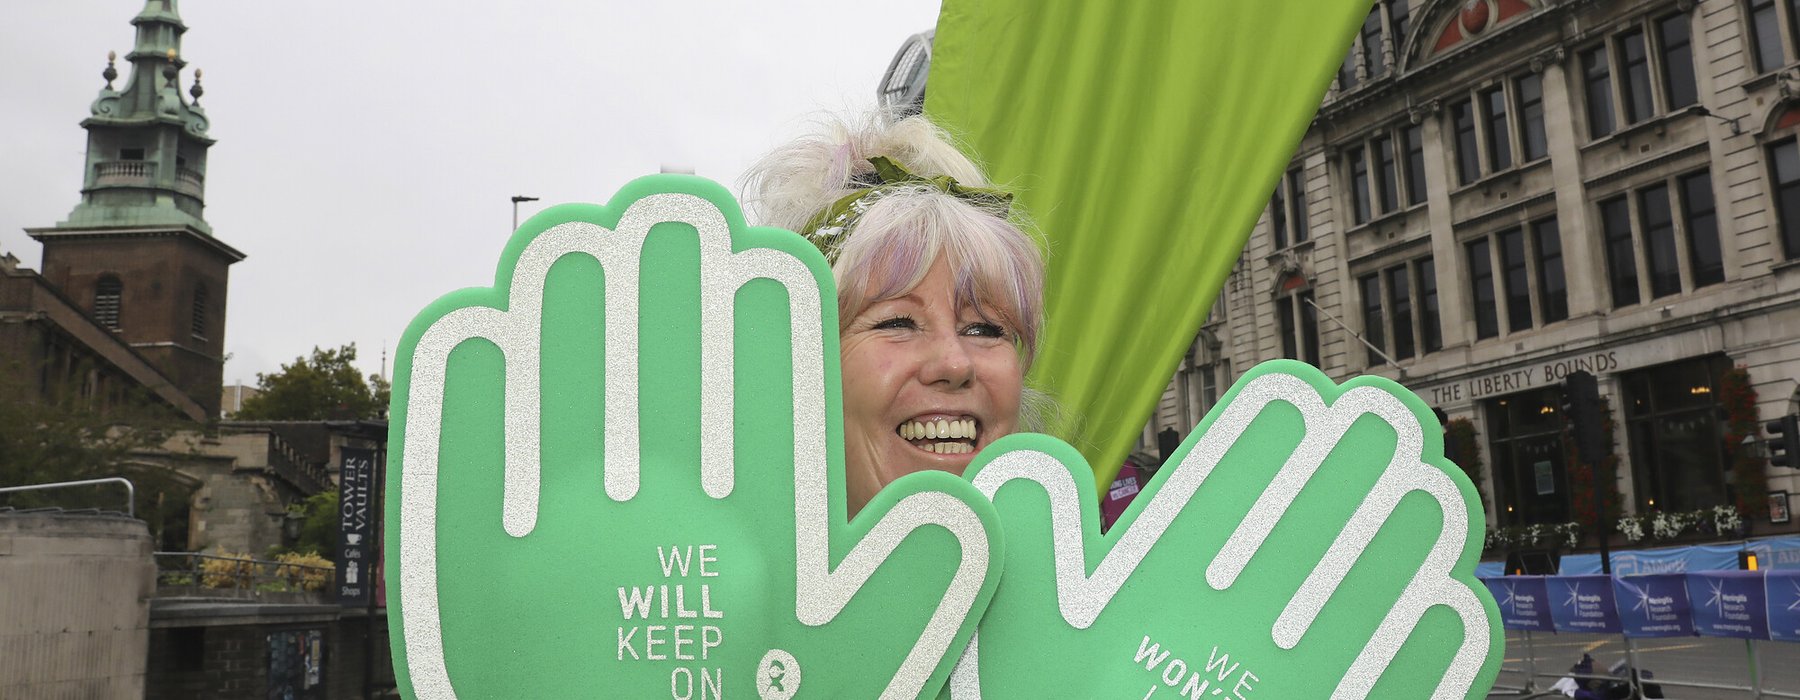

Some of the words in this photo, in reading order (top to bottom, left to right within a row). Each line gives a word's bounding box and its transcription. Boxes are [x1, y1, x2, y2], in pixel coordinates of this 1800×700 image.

[1432, 384, 1461, 404] THE
[1469, 369, 1534, 397] LIBERTY
[1544, 351, 1618, 383] BOUNDS
[342, 457, 356, 531] TOWER
[355, 460, 369, 531] VAULTS
[657, 544, 719, 577] WE
[342, 586, 361, 597] Shops
[617, 584, 724, 620] WILL
[617, 625, 723, 660] KEEP
[671, 667, 722, 700] ON
[1133, 635, 1231, 700] WON'
[1205, 646, 1260, 700] WE
